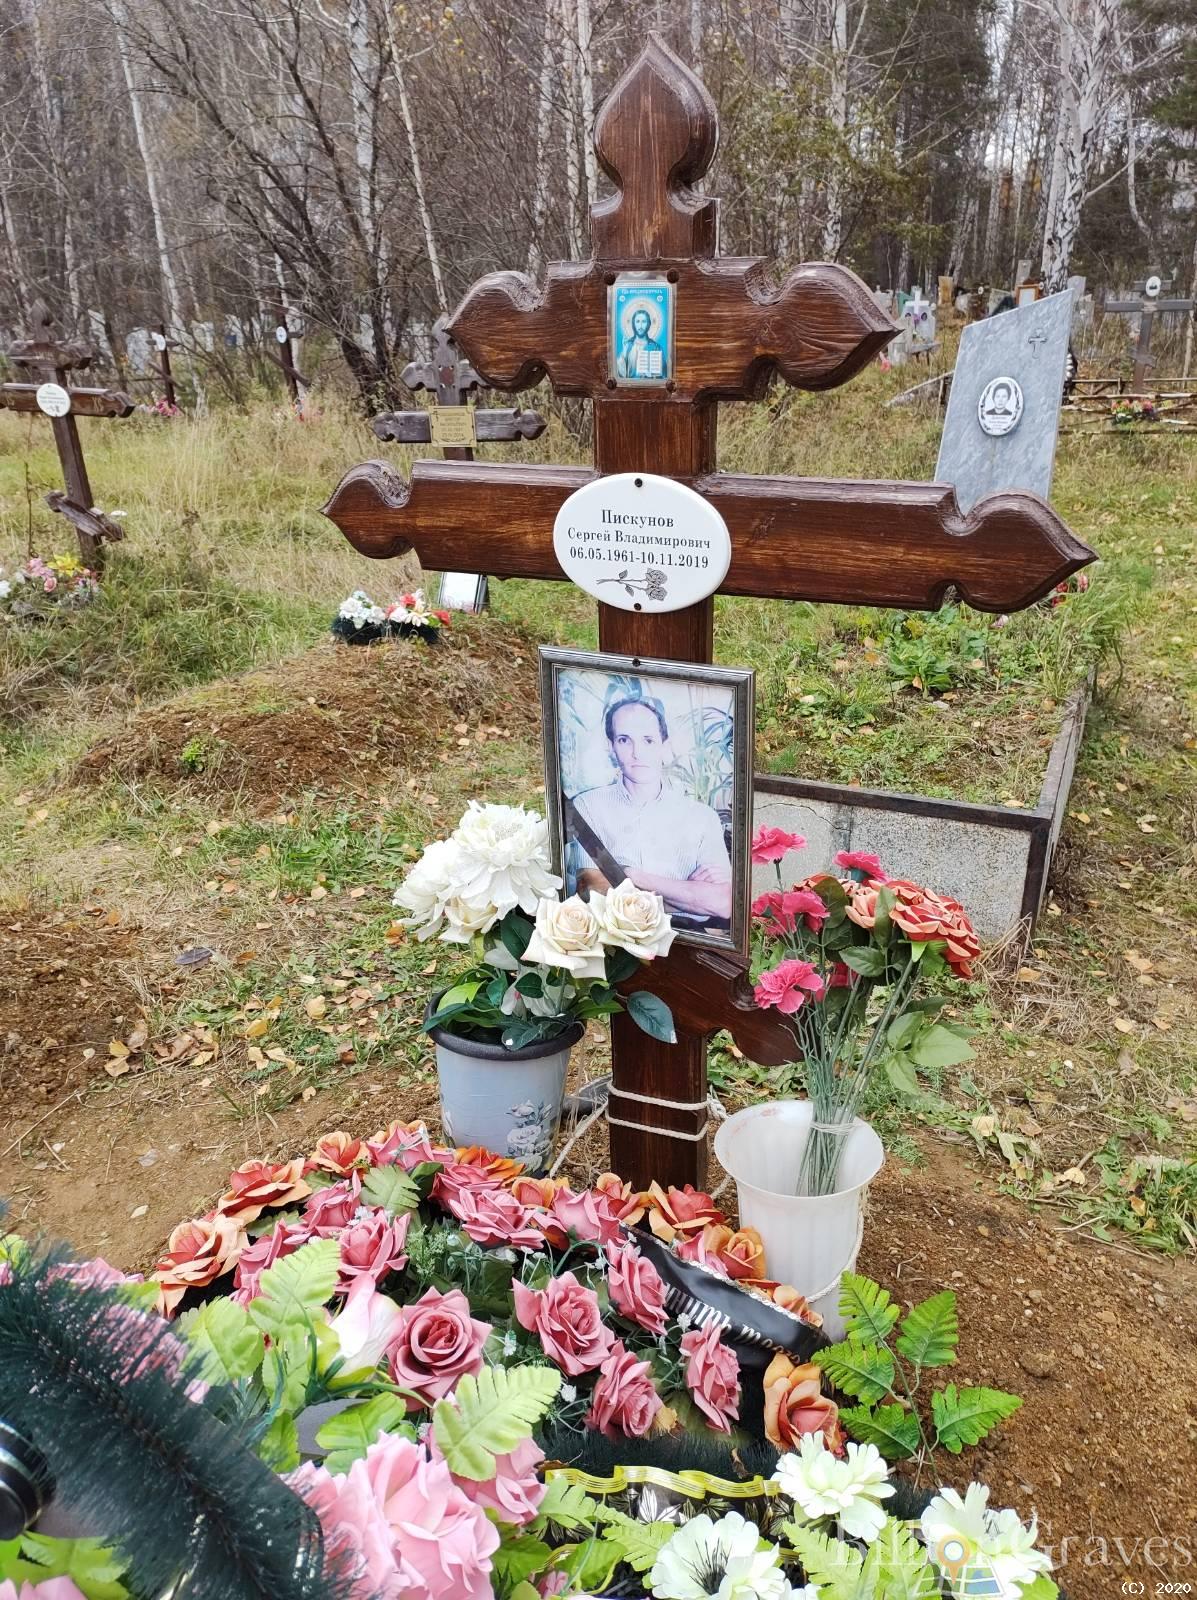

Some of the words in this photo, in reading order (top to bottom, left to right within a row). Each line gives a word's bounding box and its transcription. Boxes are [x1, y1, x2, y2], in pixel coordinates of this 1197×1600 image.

[601, 508, 674, 528] Пискунов
[567, 527, 611, 543] Сергей
[615, 530, 710, 549] Владимирович
[569, 546, 709, 568] 06.05.1961-10.11.2019
